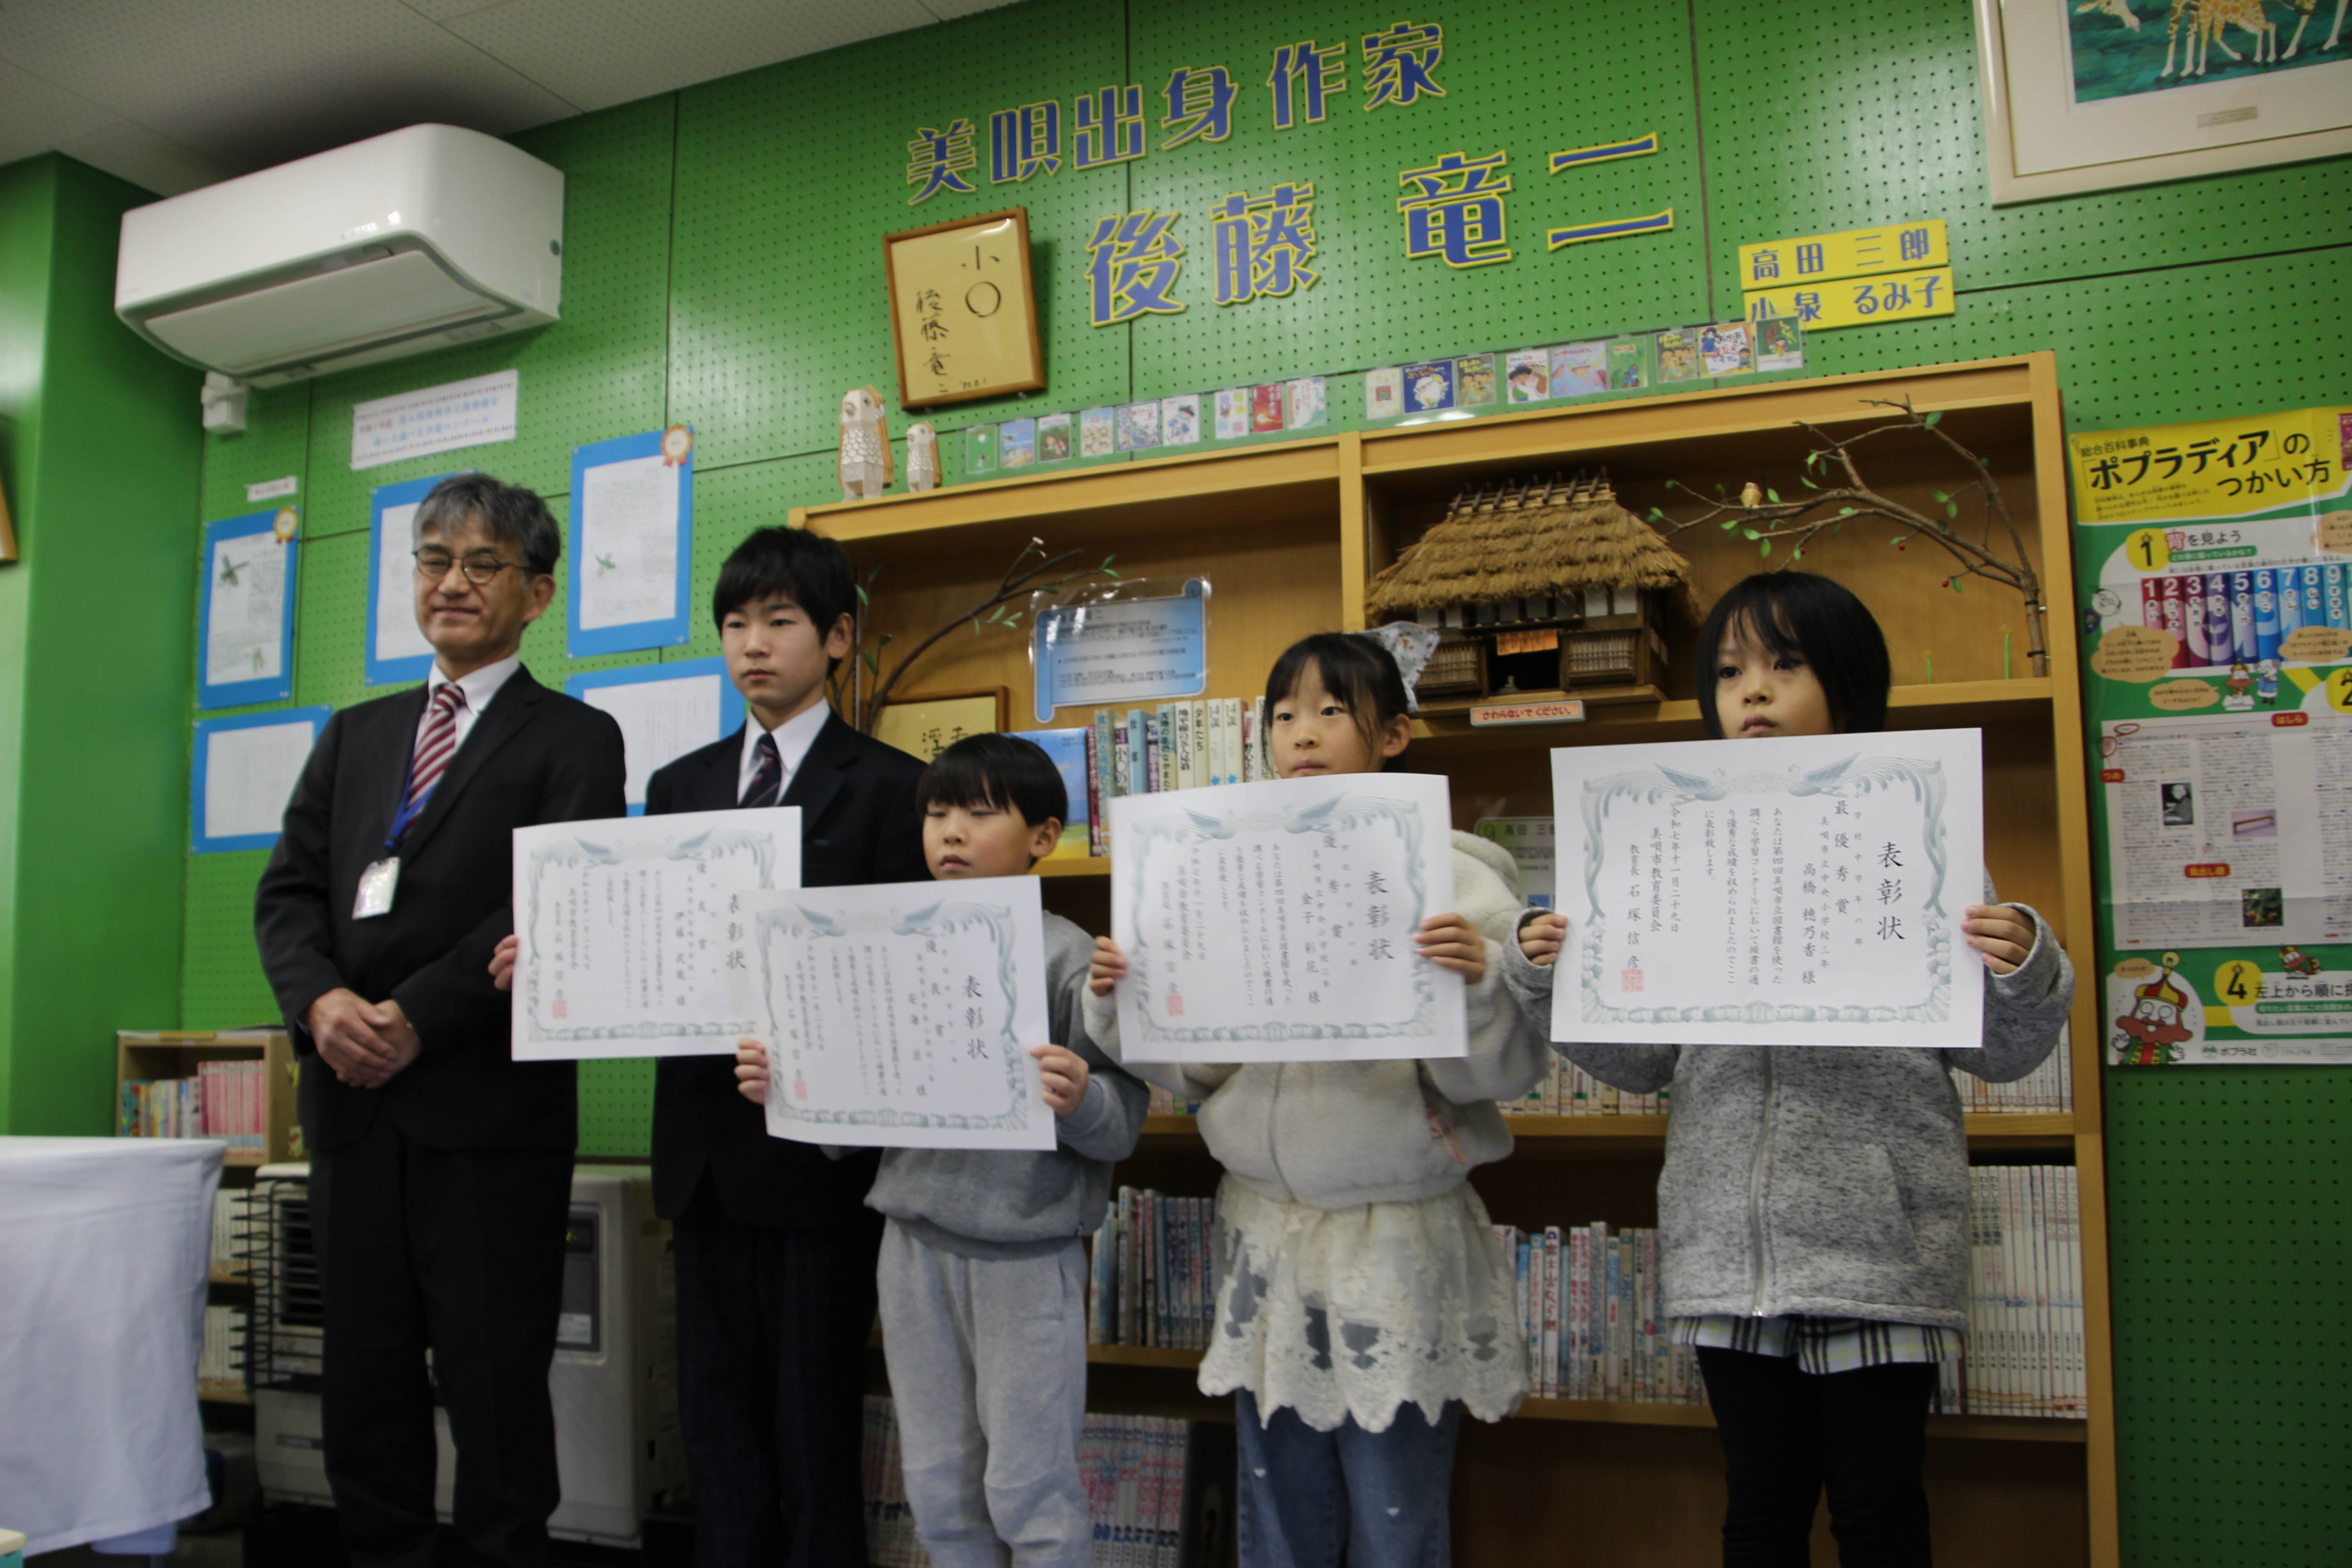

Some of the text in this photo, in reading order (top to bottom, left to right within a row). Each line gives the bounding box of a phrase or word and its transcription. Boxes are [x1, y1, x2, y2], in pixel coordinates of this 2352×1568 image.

[1853, 275, 1944, 314] るみ子
[2081, 436, 2150, 457] 総合百科事典
[2217, 459, 2332, 496] つかい方
[2141, 541, 2152, 566] 1
[2144, 564, 2342, 598] 1 2 3 4 5 6 7 8 9
[1650, 827, 1663, 932] 美唄市教育委員会
[1669, 807, 1681, 932] 令和七年十一月二十九日
[1834, 800, 1850, 914] 最優秀賞
[1877, 841, 1905, 941] 表彰状
[726, 892, 747, 970] 表彰状
[1364, 870, 1395, 961] 表彰状
[962, 974, 990, 1061] 表彰状
[2227, 973, 2247, 999] 4
